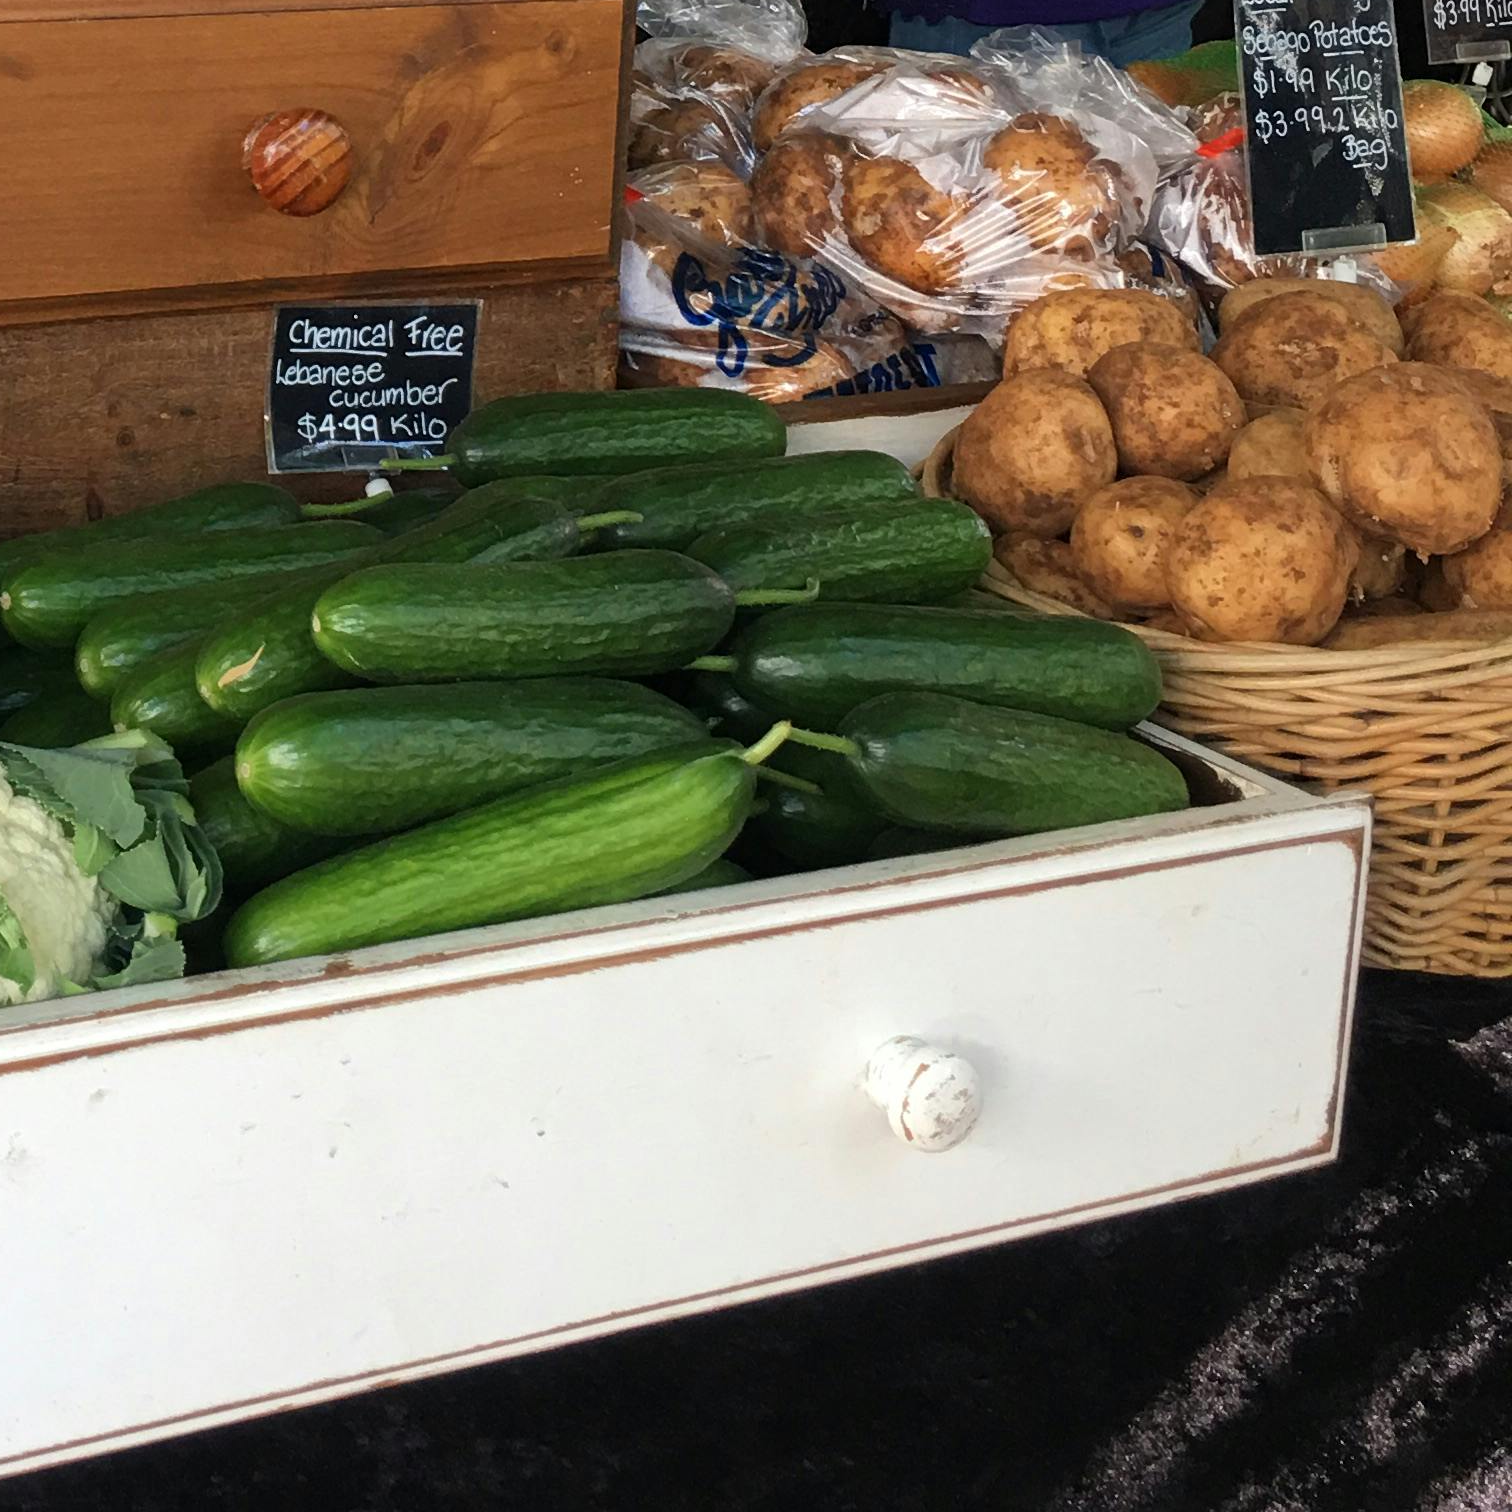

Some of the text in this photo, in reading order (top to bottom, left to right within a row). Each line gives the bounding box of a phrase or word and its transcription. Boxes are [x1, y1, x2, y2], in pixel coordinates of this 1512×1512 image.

[1309, 19, 1394, 50] Potatoes
[1253, 64, 1373, 99] $1.99 Kilo
[1352, 105, 1398, 131] Kilo
[1341, 134, 1389, 171] Bag
[288, 315, 464, 351] Chemical Free
[275, 359, 385, 386] Lebanese
[329, 378, 459, 408] cucumber
[297, 411, 447, 443] $4.99 Kilo
